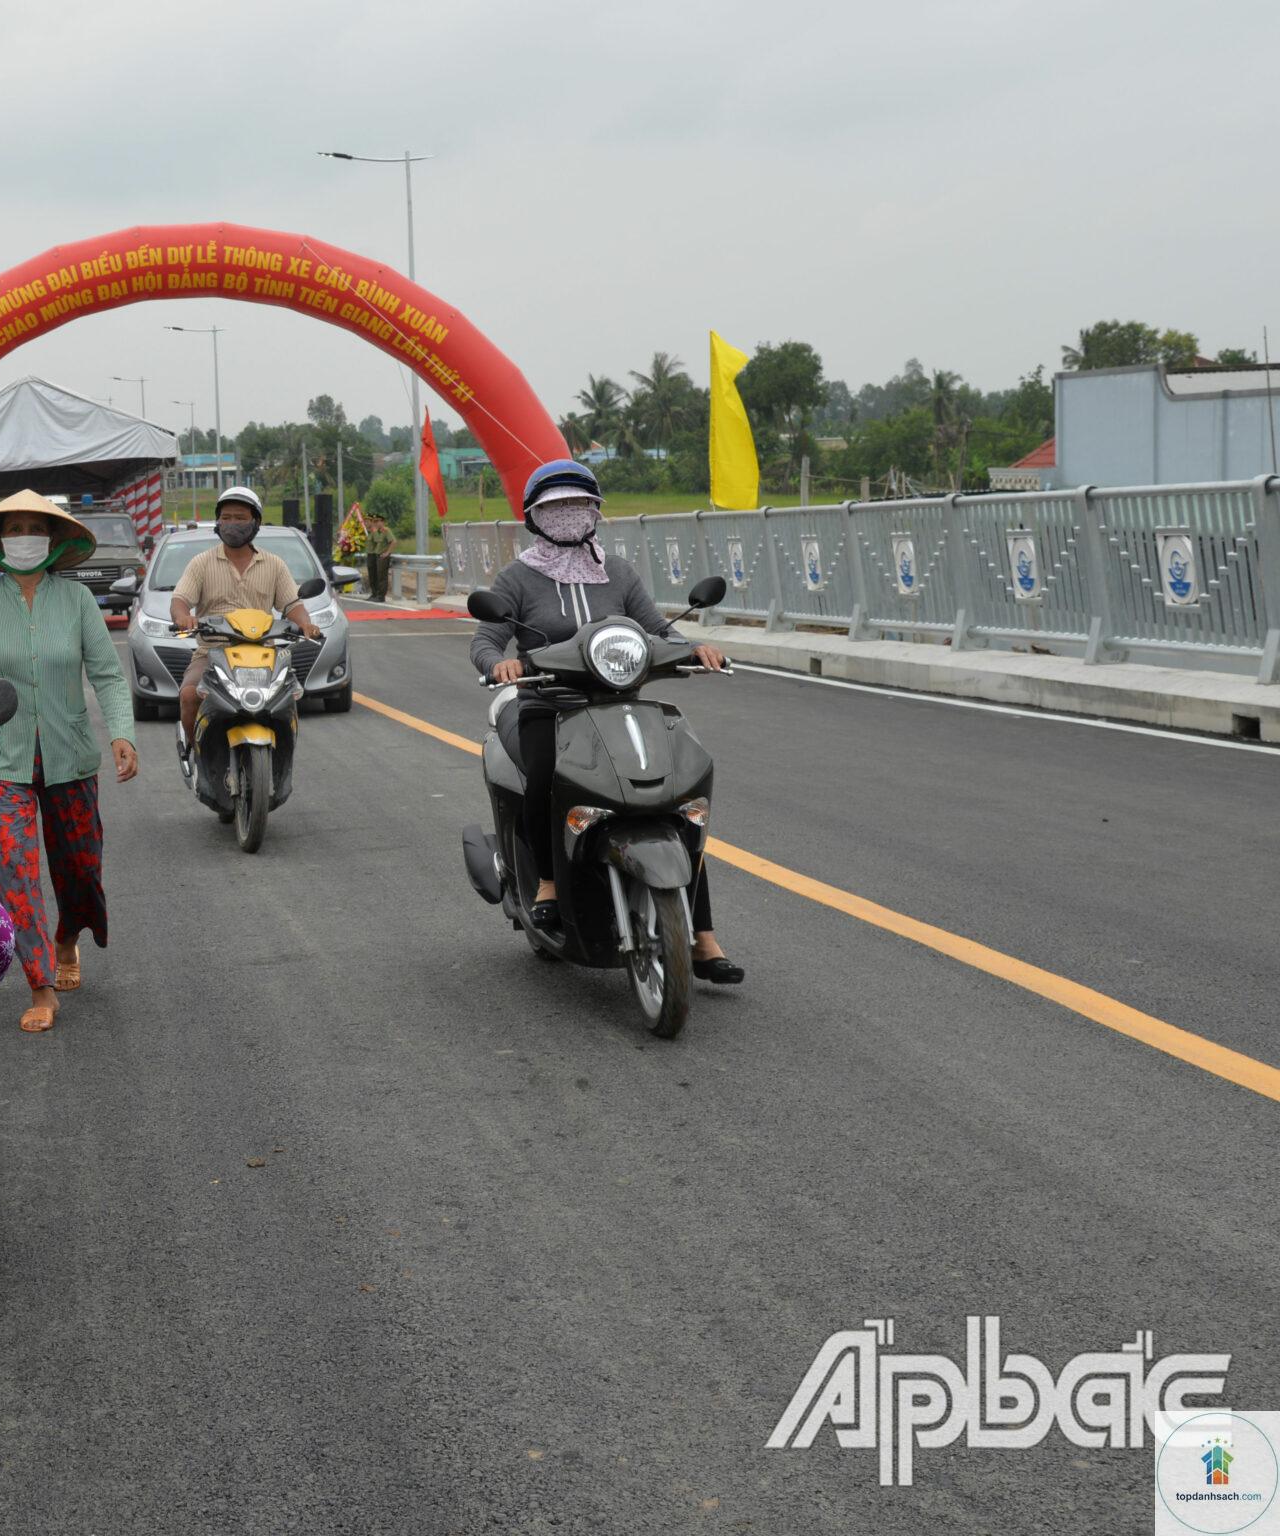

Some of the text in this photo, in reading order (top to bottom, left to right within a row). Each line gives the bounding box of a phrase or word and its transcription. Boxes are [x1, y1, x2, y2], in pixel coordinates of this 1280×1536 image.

[40, 288, 94, 322] MỪNG
[97, 280, 128, 300] ĐẠI
[131, 271, 163, 292] HỘI
[168, 268, 218, 289] ĐẢNG
[223, 272, 248, 293] BỘ
[254, 274, 296, 298] TỈNH
[339, 303, 393, 340] GIANG
[424, 353, 460, 385] THỨ
[46, 265, 79, 291] ĐẠI
[80, 250, 123, 280] BIỂU
[125, 243, 163, 269] ĐẾN
[167, 244, 193, 268] DỰ
[196, 240, 217, 264] LỄ
[223, 246, 283, 272] THÔNG
[286, 256, 312, 278] XE
[355, 279, 401, 313] BÌNH
[398, 304, 449, 344] XUÂN
